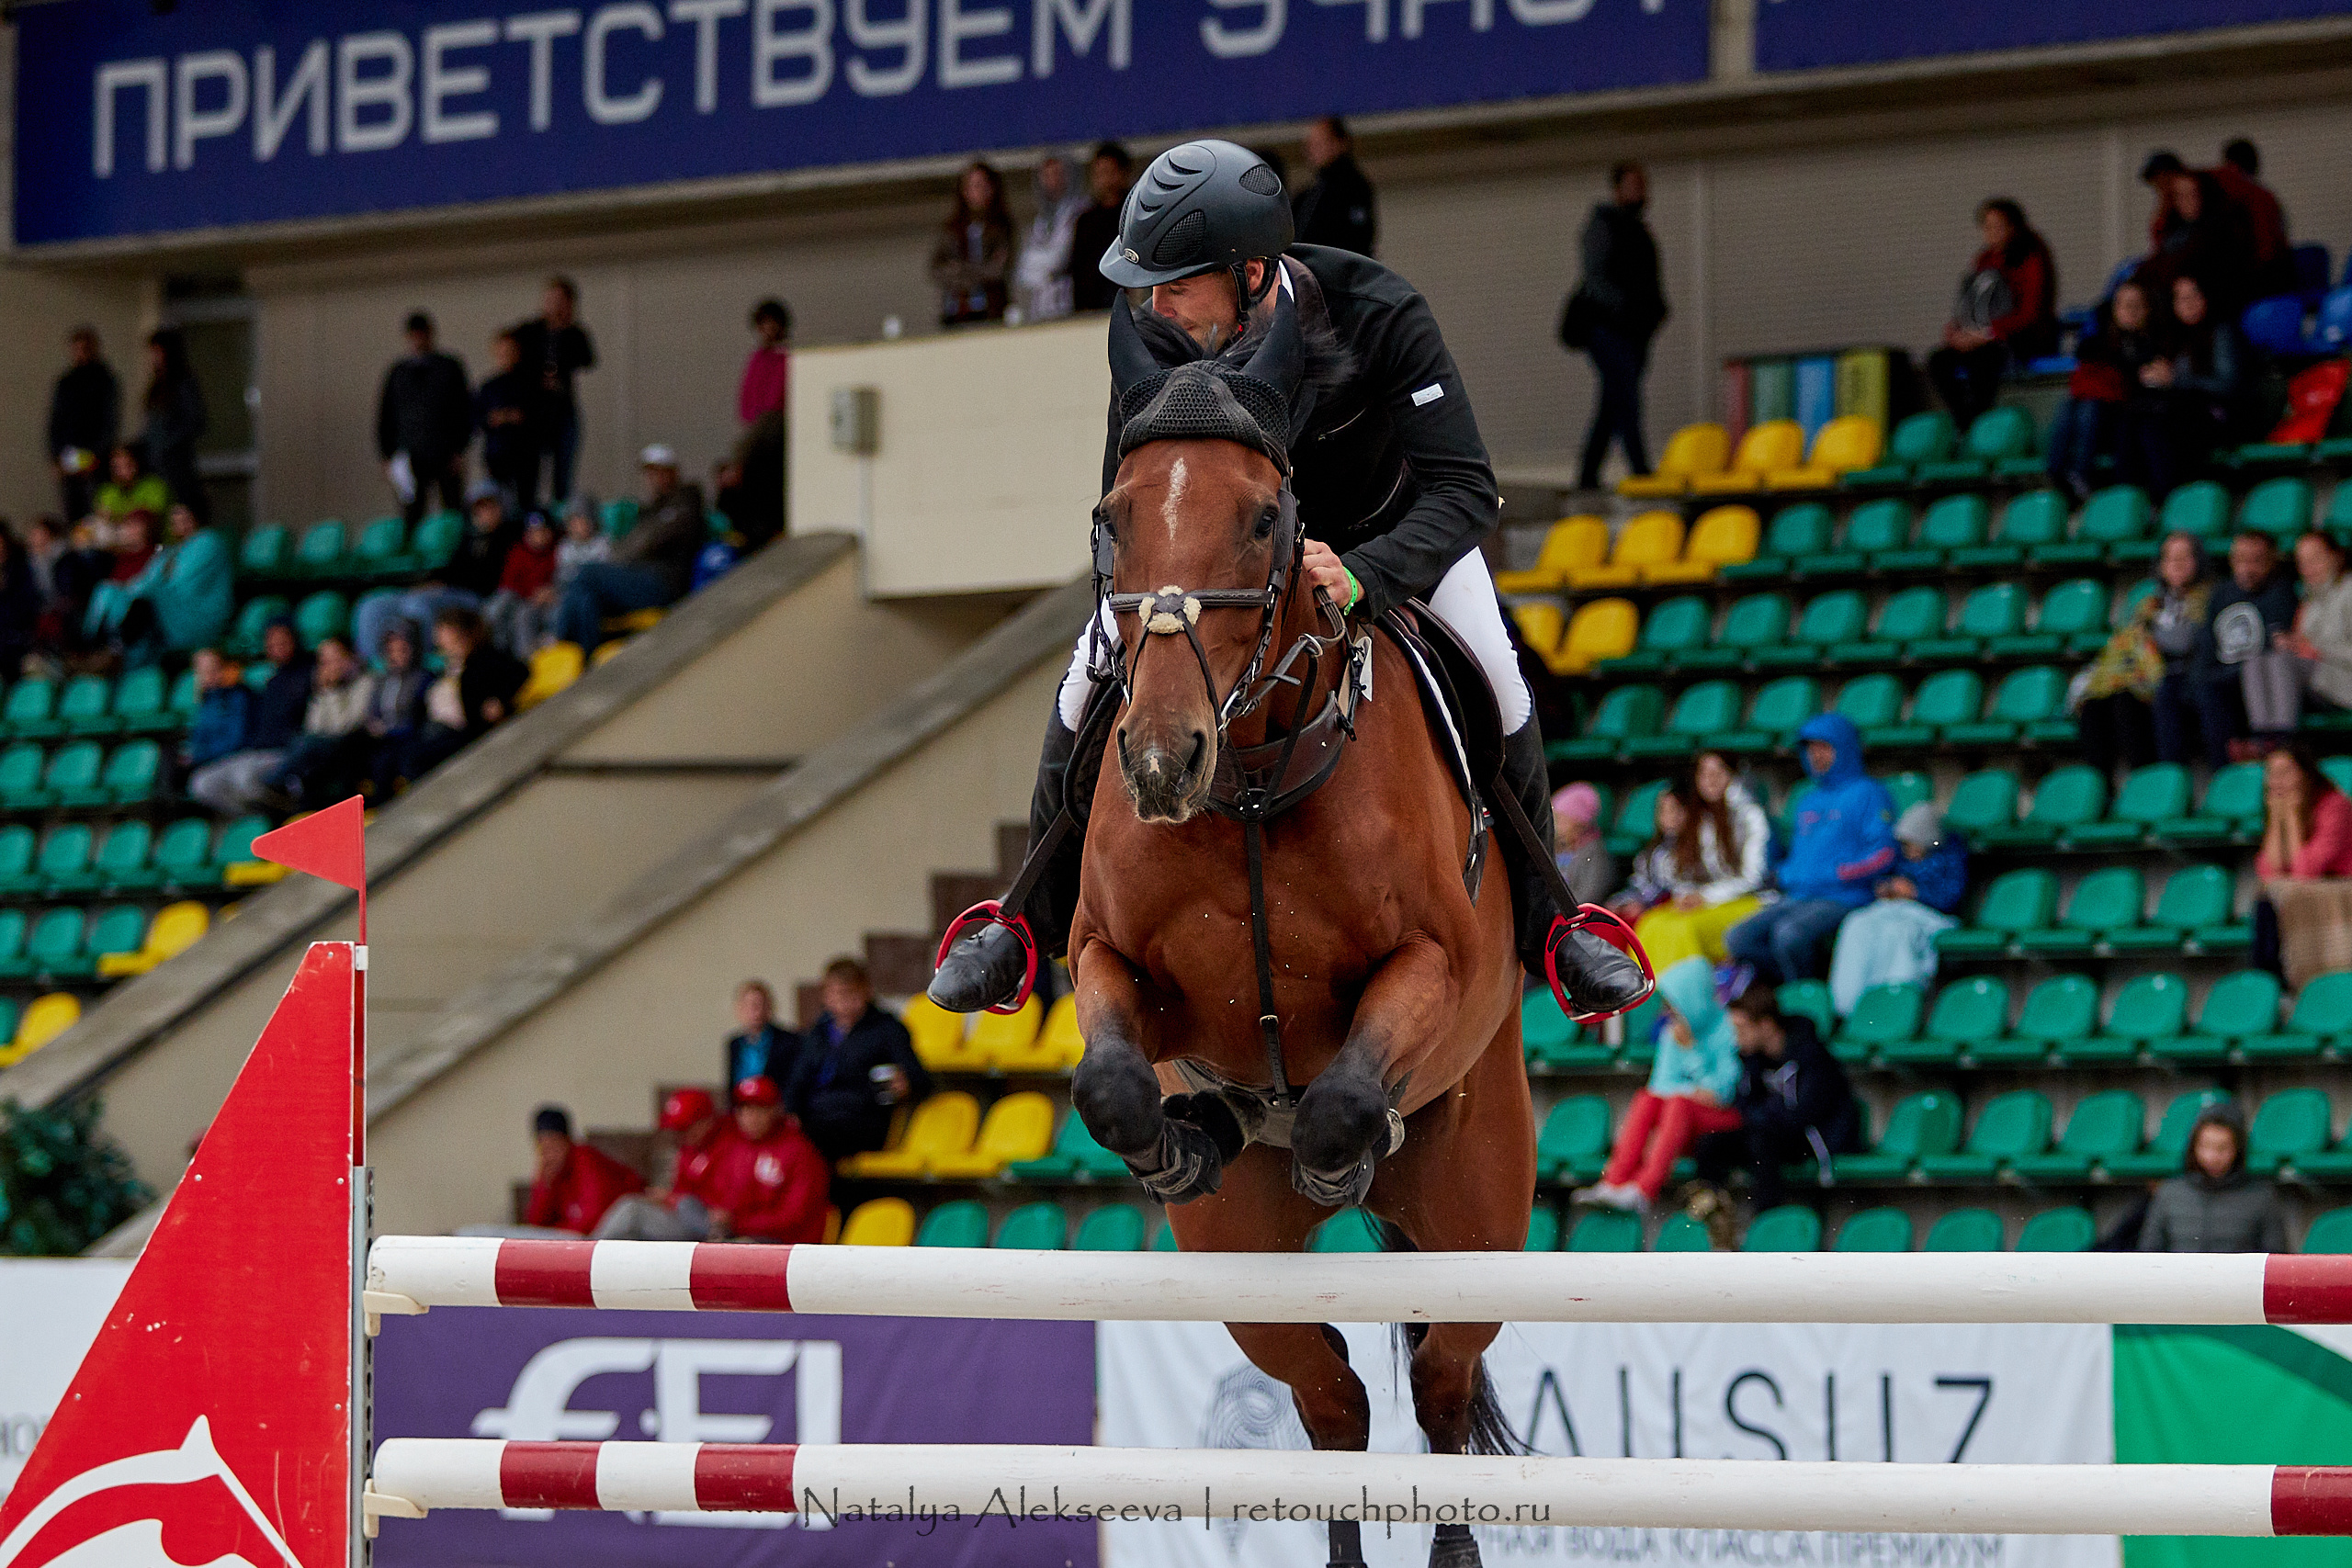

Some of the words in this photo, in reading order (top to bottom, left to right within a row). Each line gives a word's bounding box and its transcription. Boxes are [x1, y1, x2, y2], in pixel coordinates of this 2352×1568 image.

[93, 0, 1134, 178] ПРИВЕТСТВУЕМ
[470, 1337, 844, 1532] FEI
[1420, 1365, 1994, 1463] AUSUZ
